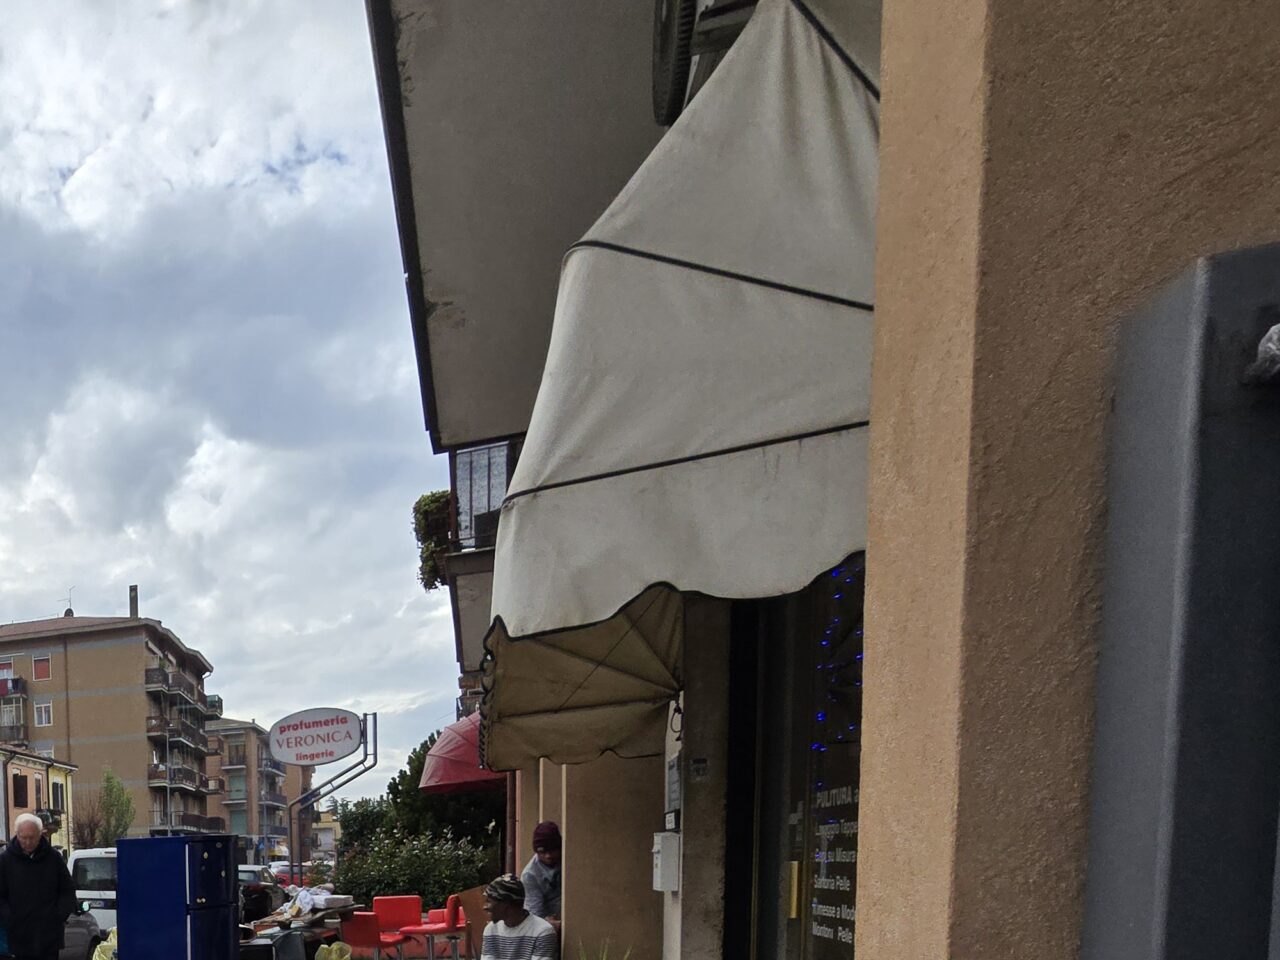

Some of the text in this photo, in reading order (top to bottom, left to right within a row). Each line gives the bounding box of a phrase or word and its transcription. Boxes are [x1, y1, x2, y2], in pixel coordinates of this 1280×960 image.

[279, 715, 348, 735] profumeria
[276, 730, 352, 749] VERONICA
[295, 749, 334, 761] lingerie
[836, 875, 851, 892] Pelle
[837, 926, 853, 944] Pelle
